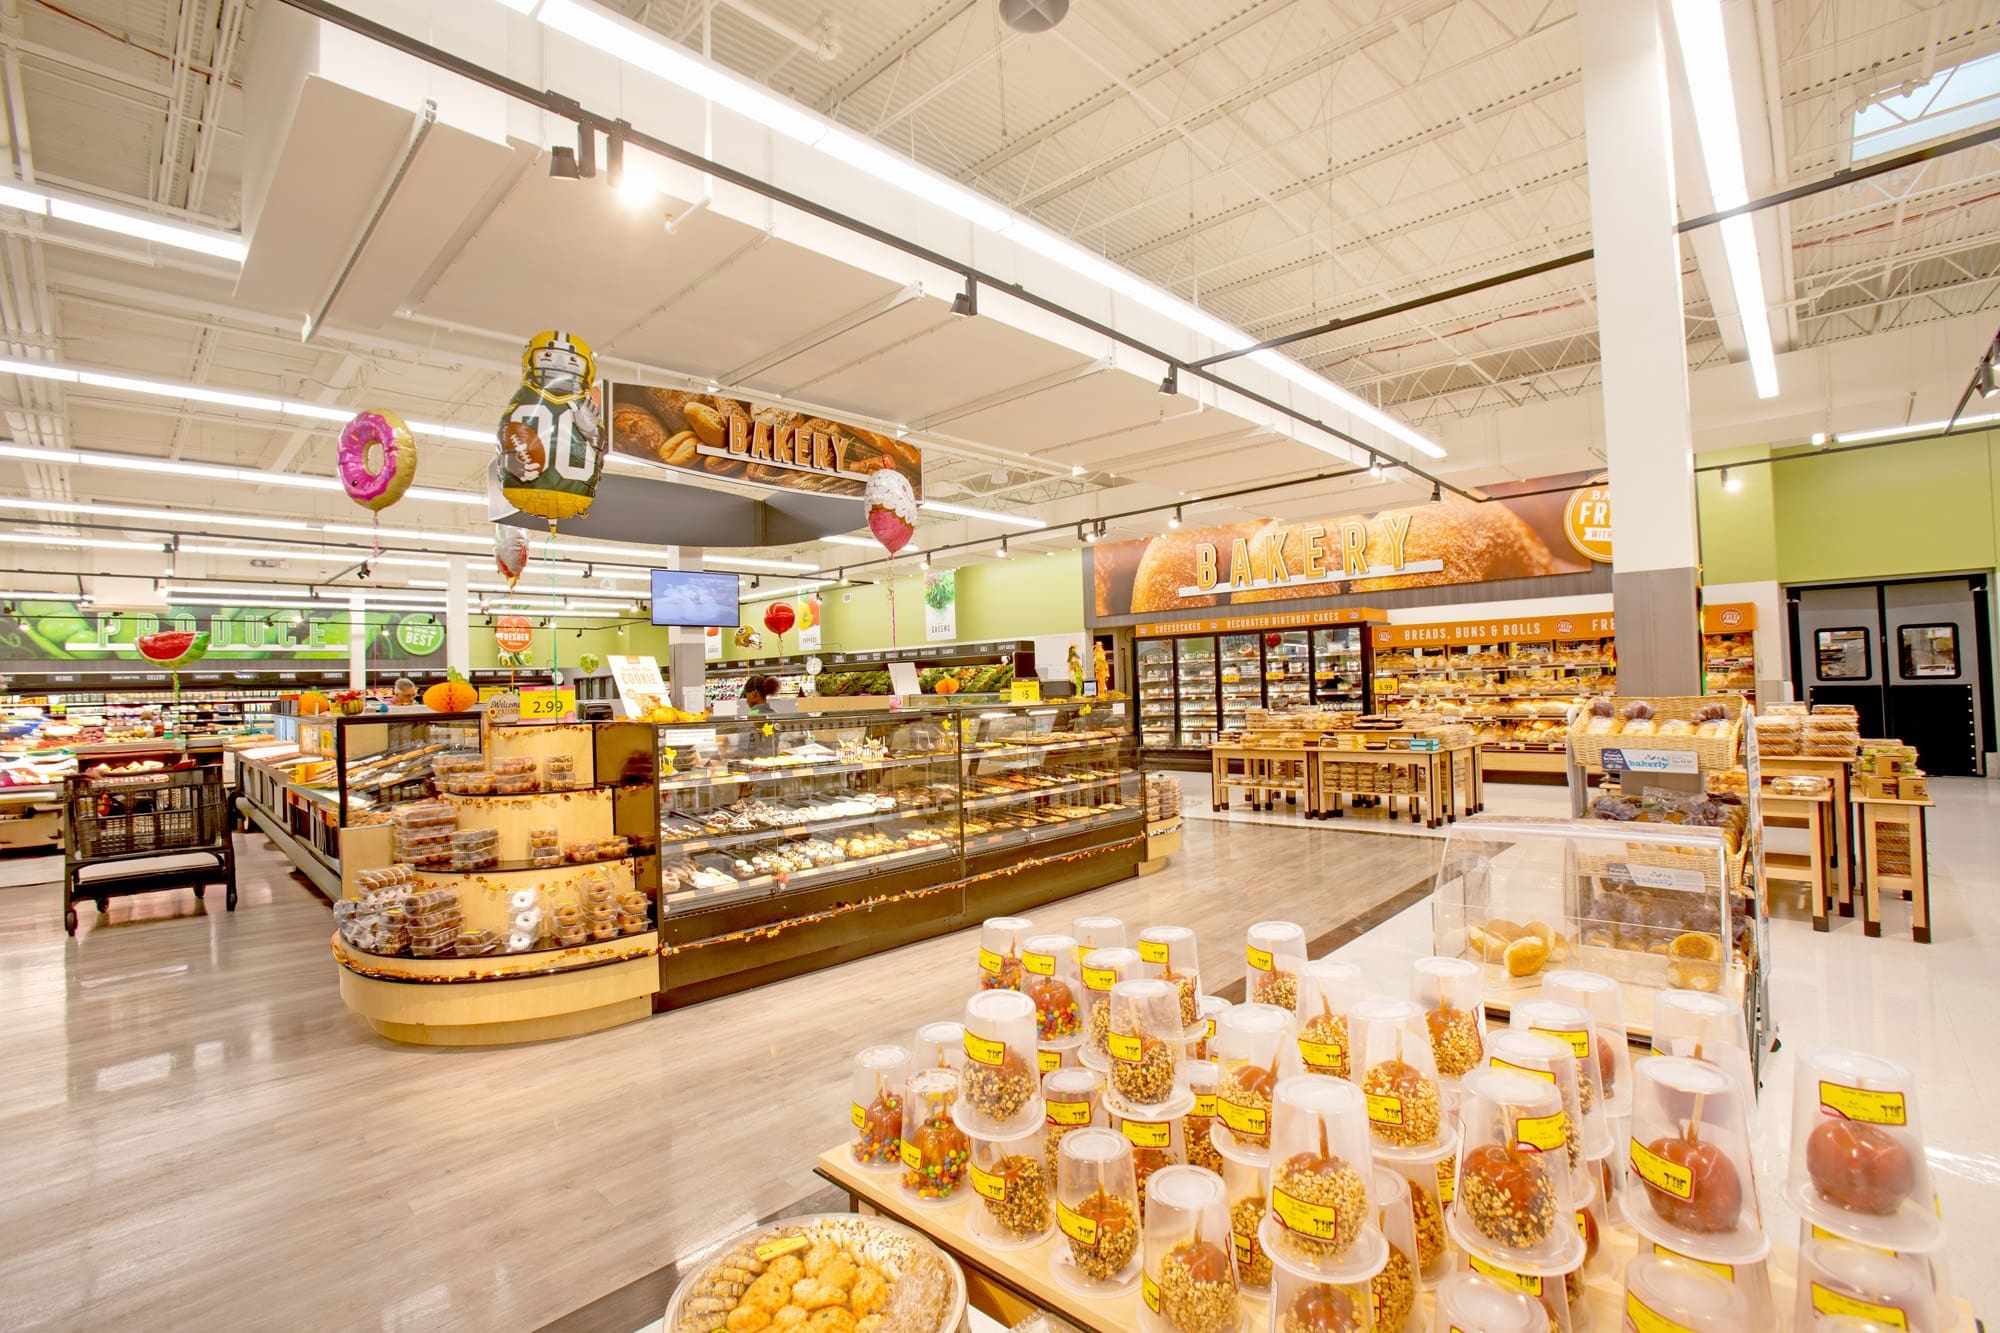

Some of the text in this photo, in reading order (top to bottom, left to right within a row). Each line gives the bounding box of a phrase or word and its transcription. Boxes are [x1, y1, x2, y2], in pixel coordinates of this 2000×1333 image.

[729, 415, 849, 472] BAKERY
[1592, 490, 1610, 501] BA
[1579, 501, 1612, 525] FR
[1196, 514, 1411, 590] BAKERY
[1226, 617, 1269, 628] DECORATED
[1272, 614, 1311, 625] BIRTHDAY
[1313, 612, 1339, 622] CAKES
[1592, 618, 1615, 631] FRE
[932, 624, 951, 633] GREENS
[1154, 622, 1201, 633] CHEESECAKES
[1404, 628, 1451, 641] BREADS,
[1456, 626, 1485, 638] BUNS
[1491, 624, 1498, 637] &
[1503, 622, 1541, 636] ROLLS
[405, 631, 435, 647] BEST
[621, 672, 658, 685] COOKIE
[532, 700, 563, 714] 2.99
[1629, 759, 1669, 770] bakerly
